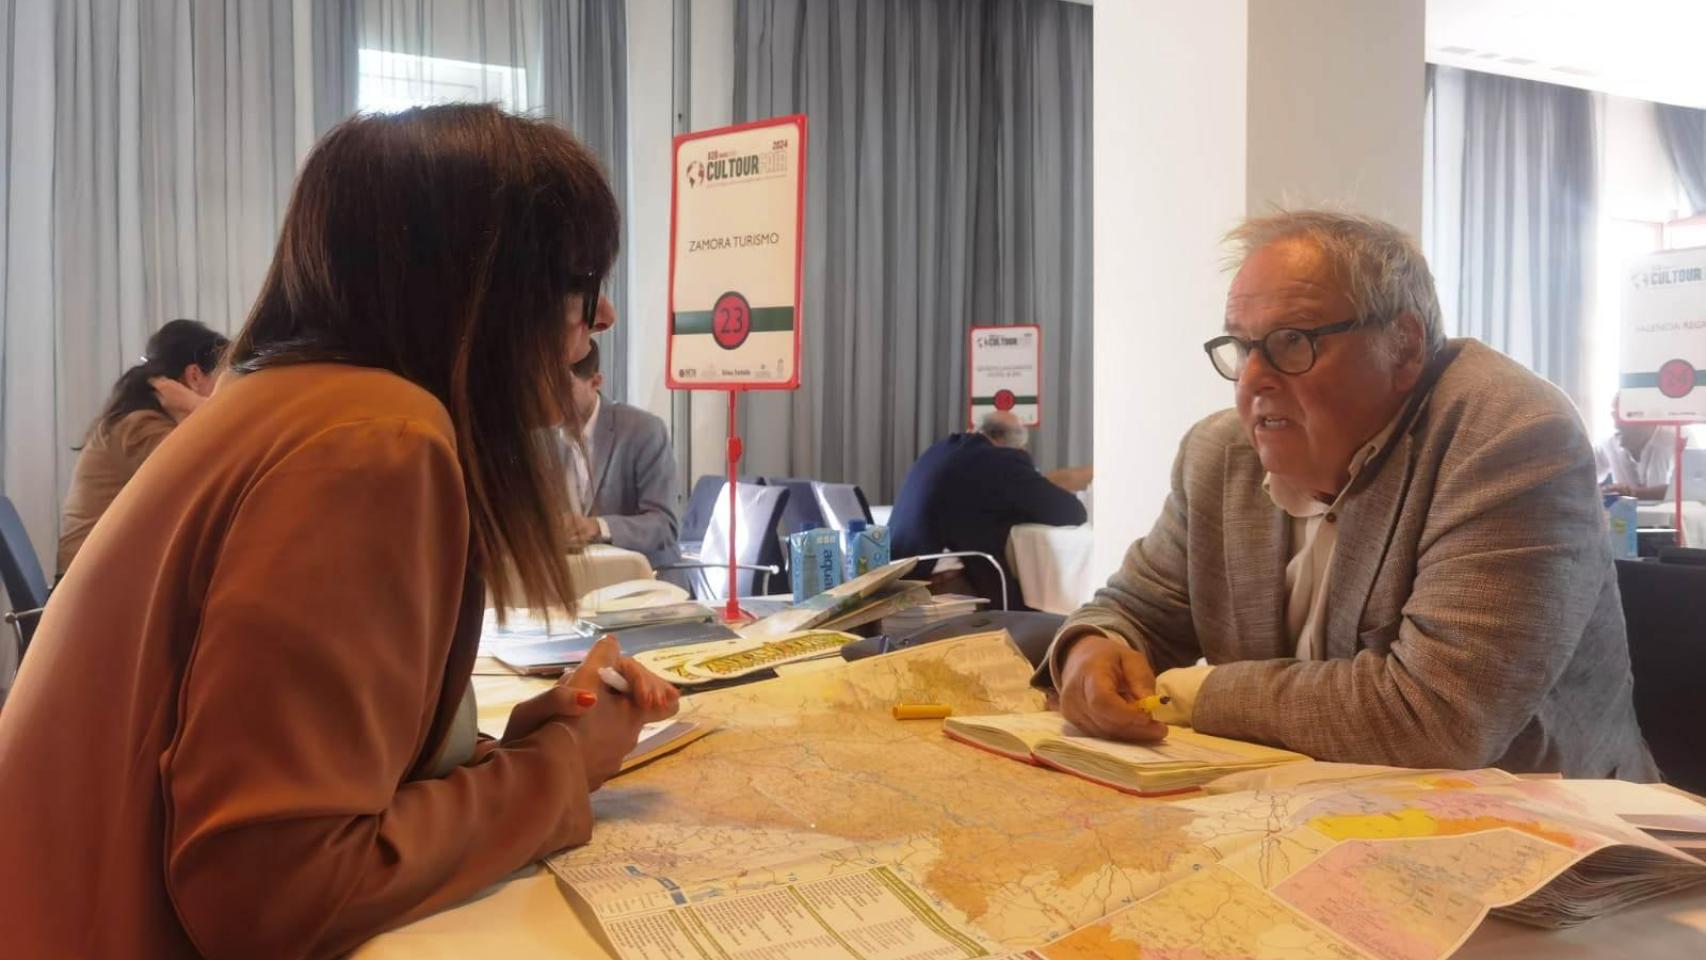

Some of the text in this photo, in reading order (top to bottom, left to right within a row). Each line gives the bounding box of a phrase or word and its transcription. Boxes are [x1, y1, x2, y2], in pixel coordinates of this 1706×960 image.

[706, 154, 759, 181] CULTOUR
[689, 232, 779, 252] ZAMORA TURISMO
[721, 306, 743, 334] 23
